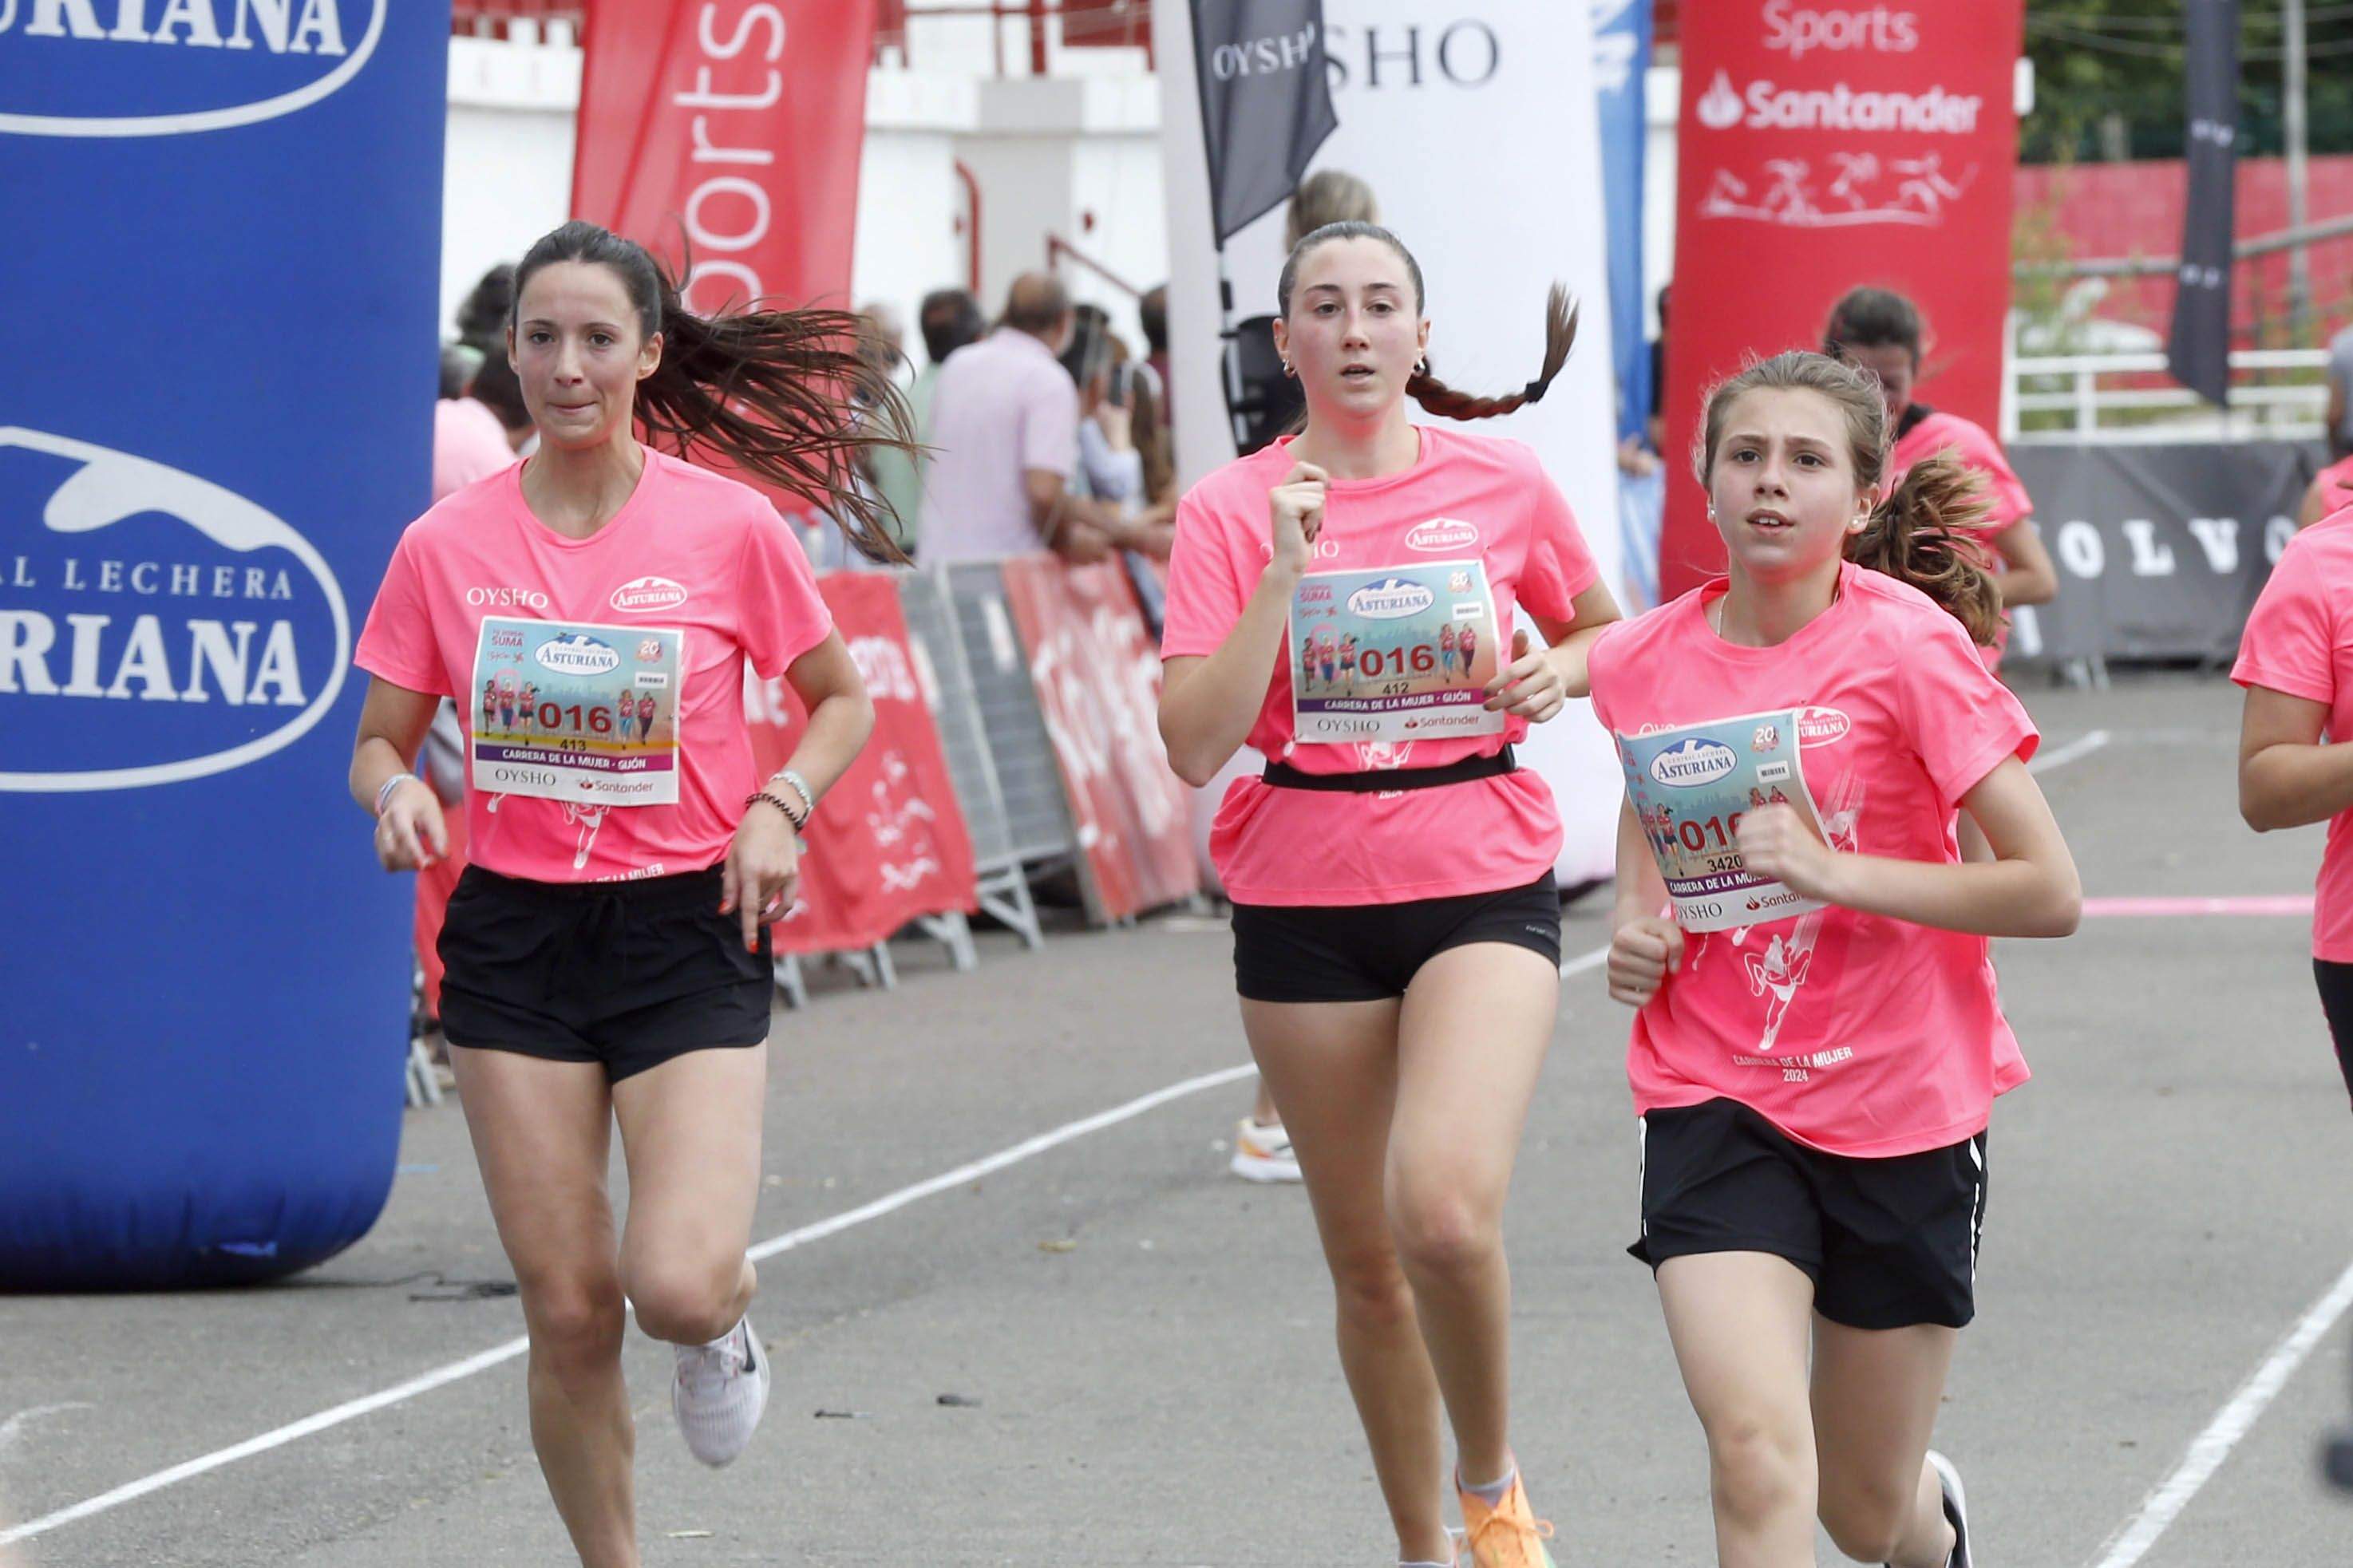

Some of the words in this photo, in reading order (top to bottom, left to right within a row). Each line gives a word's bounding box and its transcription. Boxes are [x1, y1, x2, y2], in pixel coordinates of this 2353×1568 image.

[1761, 0, 1919, 61] Sports
[1212, 21, 1316, 81] OYSH
[1745, 77, 1983, 135] Santander
[63, 558, 292, 600] LECHERA
[466, 587, 549, 610] OYSHO
[1353, 594, 1429, 613] ASTURIANA
[640, 640, 660, 654] 20
[541, 646, 614, 668] ASTURIANA
[1359, 644, 1434, 677] 016
[1382, 681, 1410, 696] 412
[1324, 700, 1369, 710] CARRERA
[1371, 699, 1384, 710] DE
[1386, 697, 1399, 709] LA
[1401, 693, 1434, 708] MUJER
[538, 702, 613, 733] 016
[1317, 718, 1380, 733] OYSHO
[1420, 715, 1479, 728] Santander
[1755, 726, 1774, 743] 20
[560, 739, 587, 752] 413
[502, 748, 546, 762] CARRERA
[548, 753, 561, 764] DE
[563, 755, 575, 765] LA
[577, 755, 610, 769] MUJER
[1658, 755, 1732, 780] ASTURIANA
[495, 767, 556, 786] OYSHO
[595, 780, 654, 793] Santander
[1707, 855, 1743, 873] 3420
[1706, 878, 1719, 890] DE
[1721, 875, 1734, 888] LA
[1780, 1056, 1793, 1068] DE
[1796, 1054, 1811, 1068] LA
[1812, 1046, 1853, 1068] MUJER
[1782, 1068, 1809, 1082] 2024
